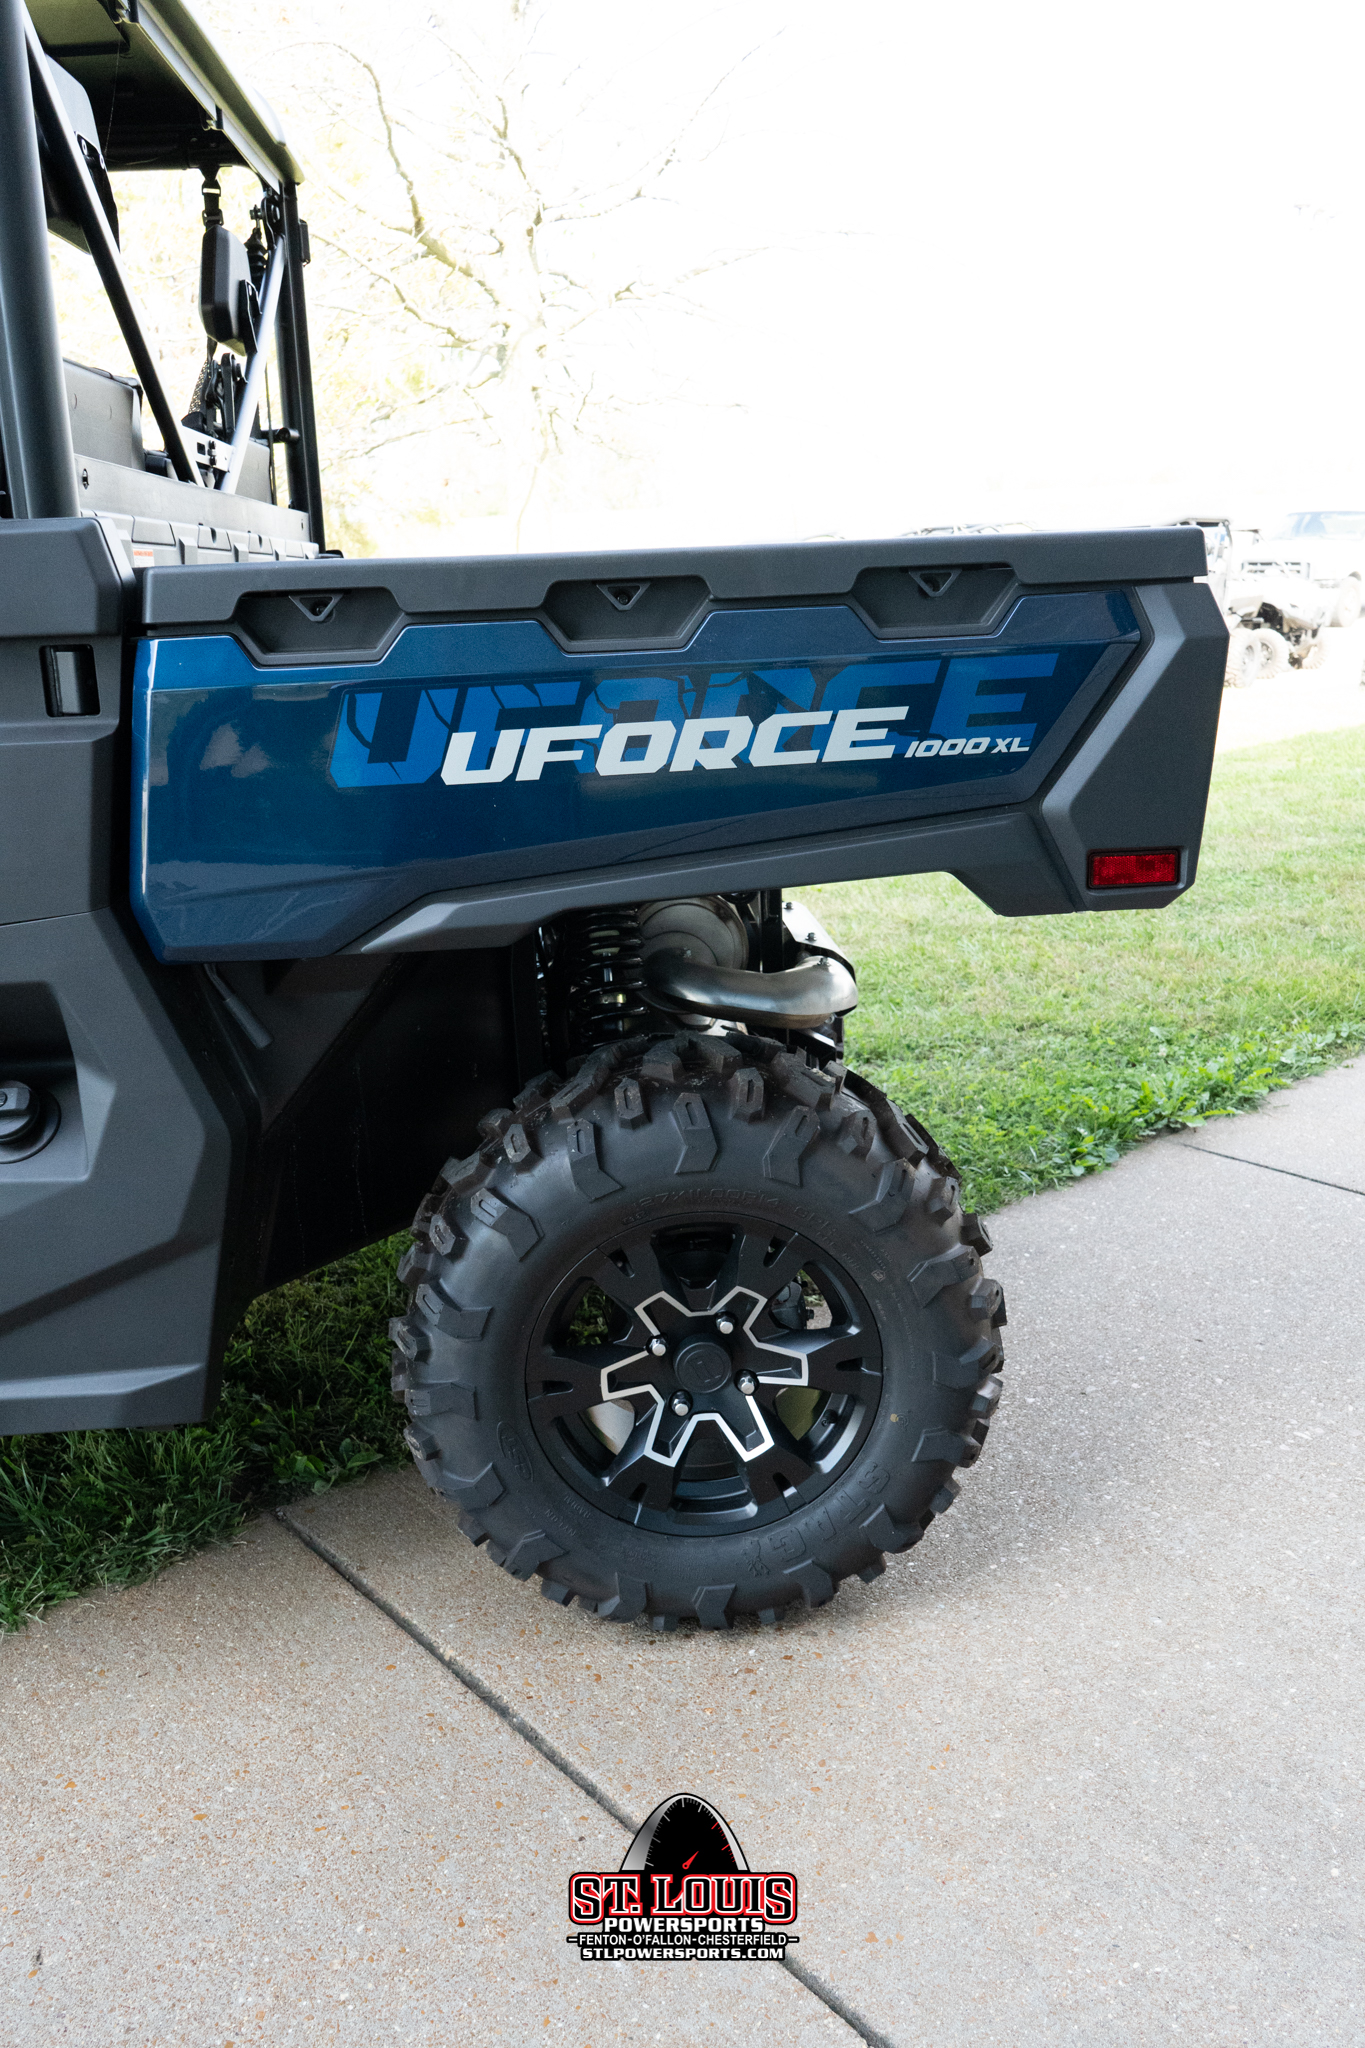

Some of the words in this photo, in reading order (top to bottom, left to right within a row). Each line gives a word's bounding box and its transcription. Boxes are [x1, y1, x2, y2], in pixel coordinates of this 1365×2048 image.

[440, 706, 909, 786] UFORCE
[903, 737, 991, 758] 1000
[990, 737, 1030, 754] XL
